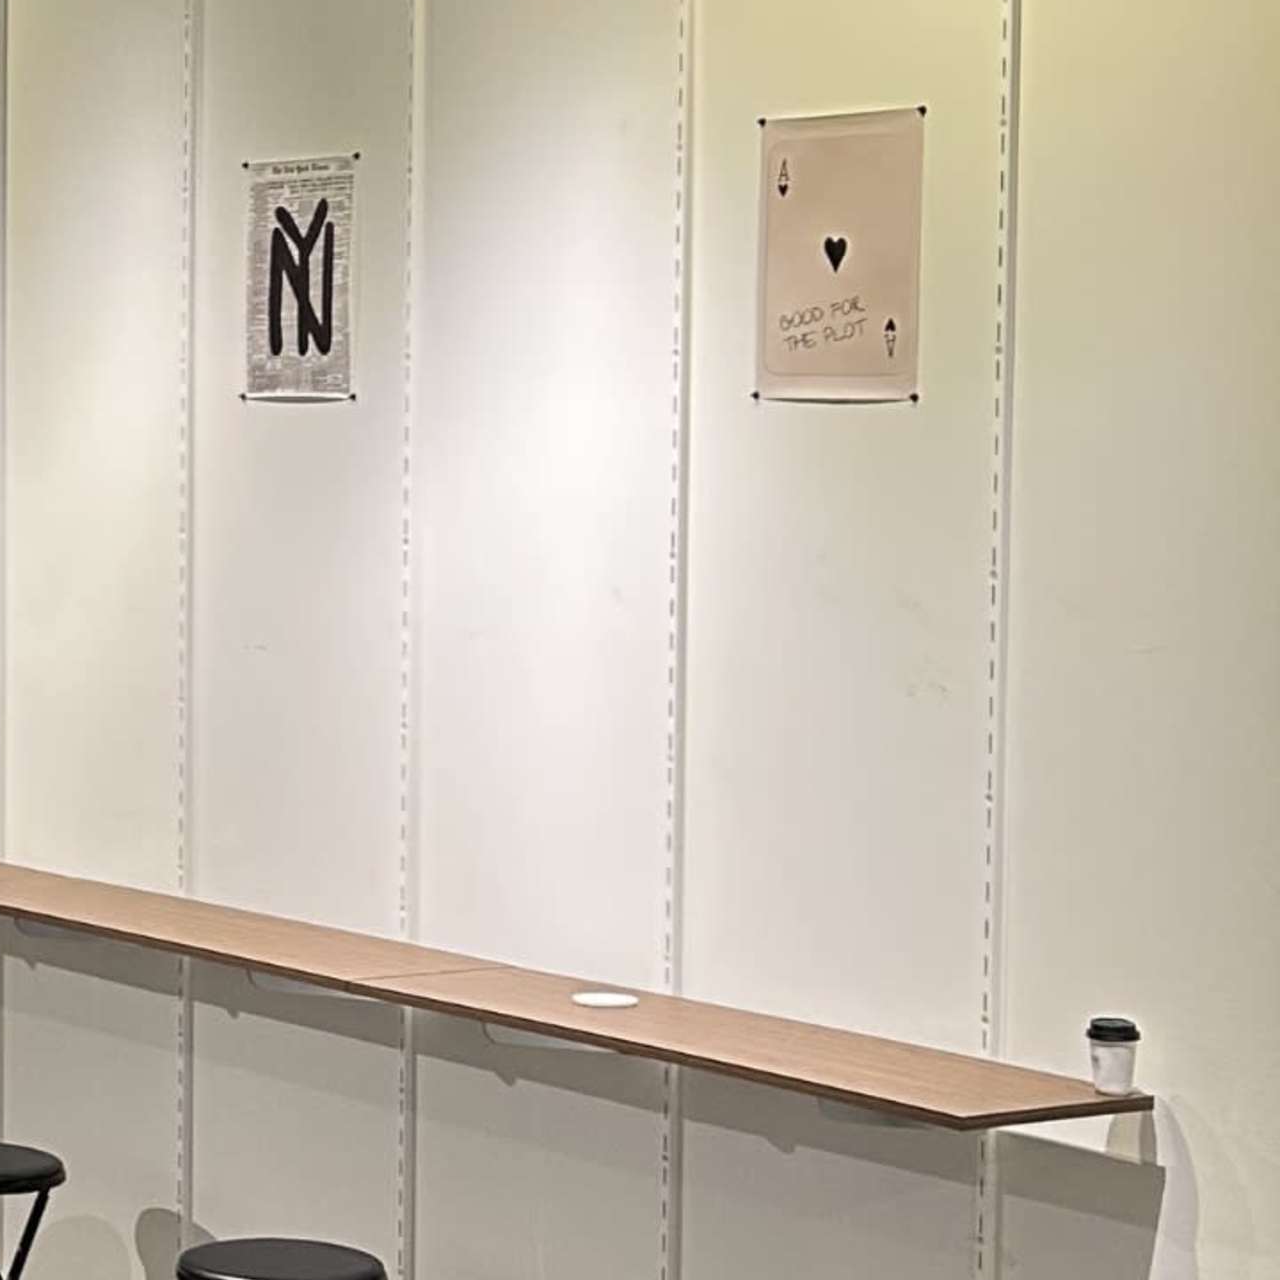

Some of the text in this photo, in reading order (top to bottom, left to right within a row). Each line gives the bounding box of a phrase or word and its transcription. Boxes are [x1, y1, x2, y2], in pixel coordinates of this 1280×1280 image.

[777, 158, 789, 181] A
[780, 306, 824, 331] GOOD
[783, 318, 868, 351] THE PLOT
